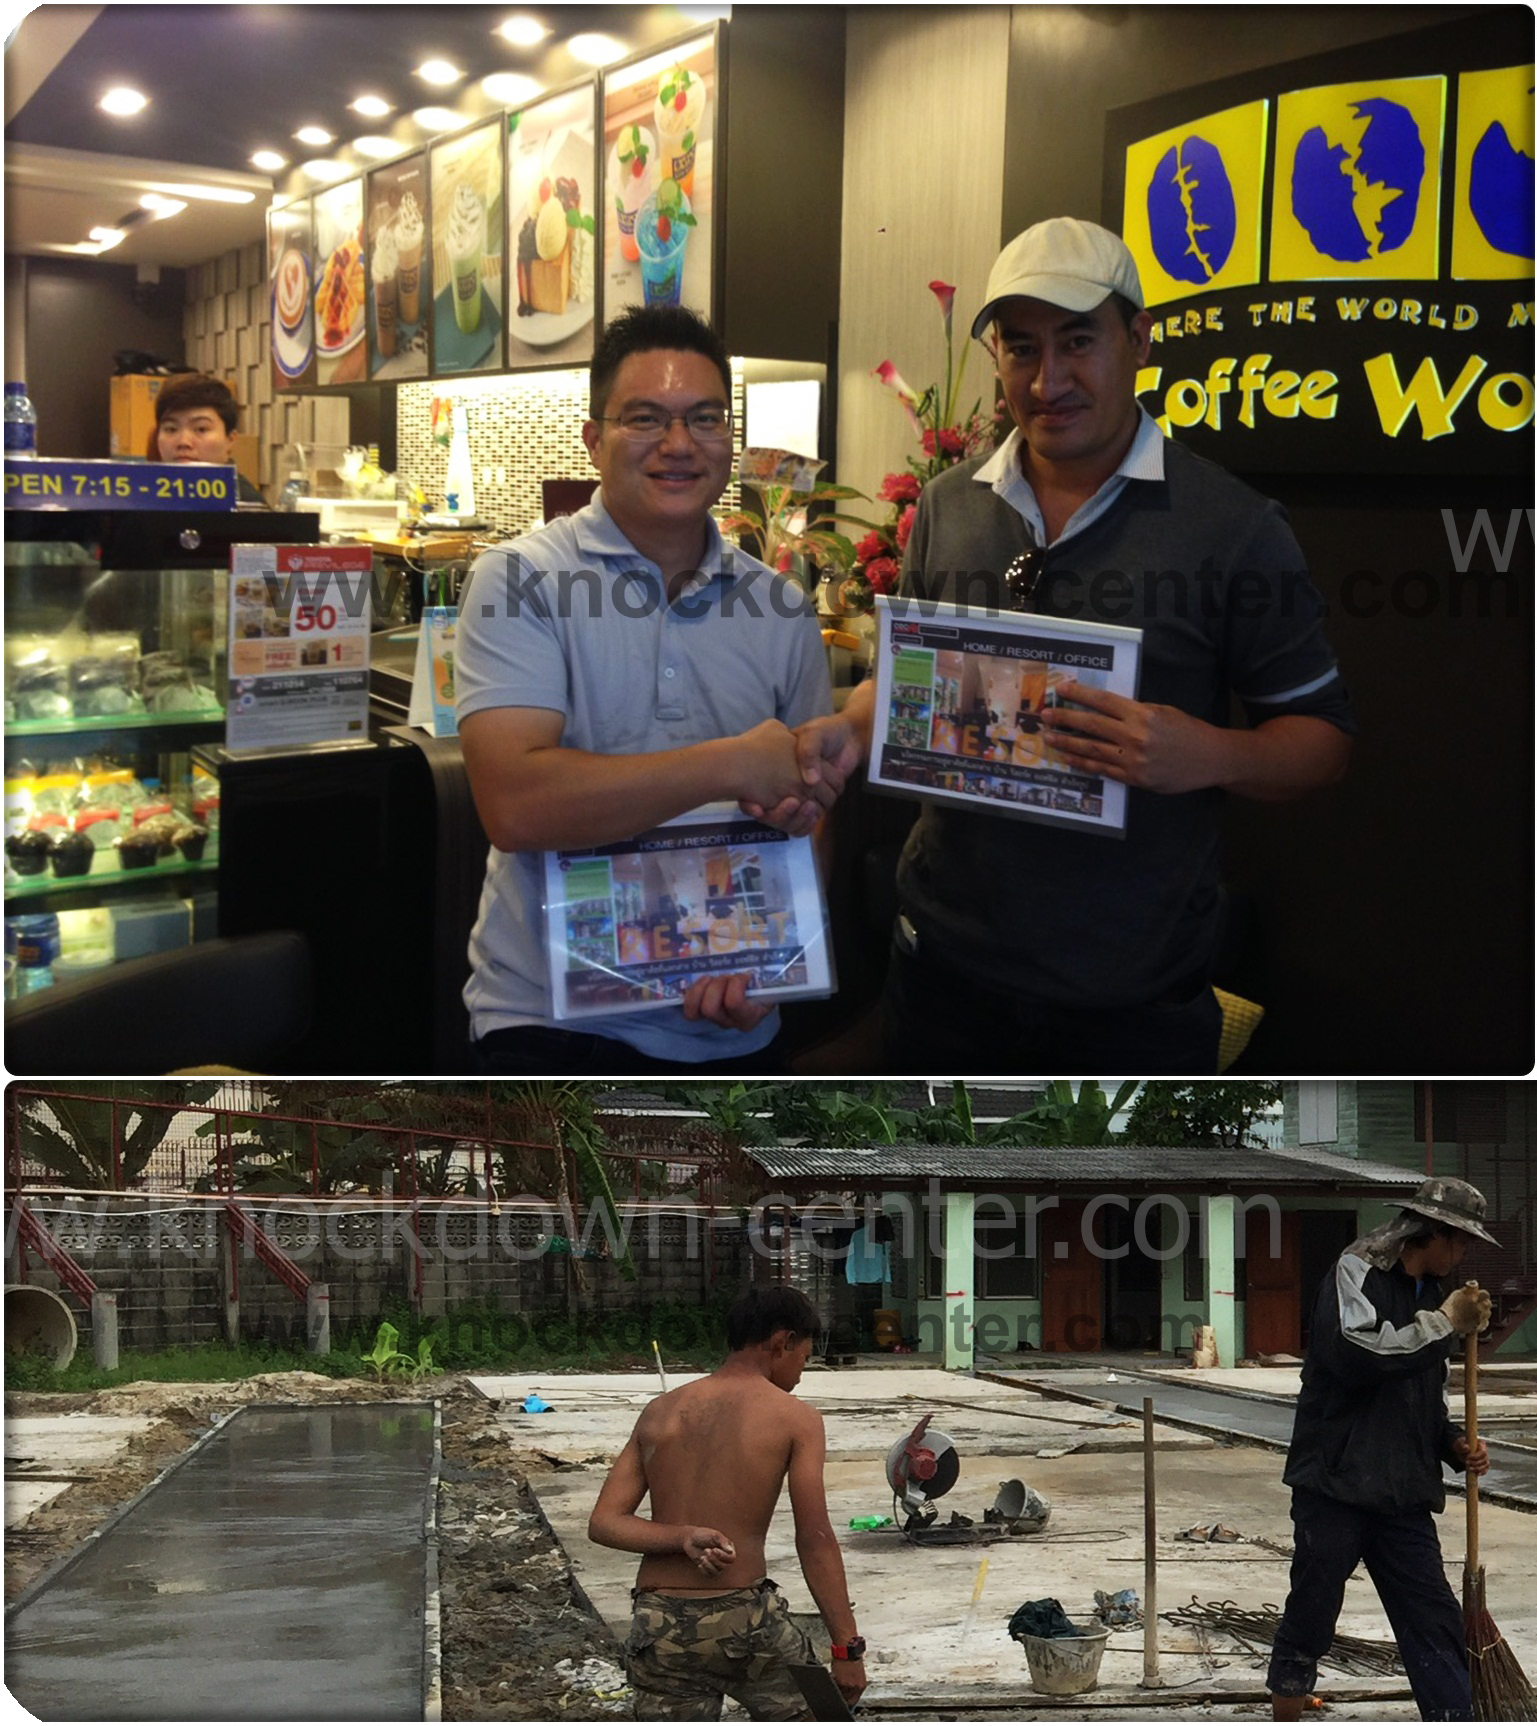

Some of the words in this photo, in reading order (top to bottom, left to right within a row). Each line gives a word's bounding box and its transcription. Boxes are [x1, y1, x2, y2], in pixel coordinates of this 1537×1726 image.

[1148, 306, 1224, 344] HERE
[1247, 296, 1316, 327] THE
[1335, 297, 1479, 332] WORLD
[1506, 301, 1536, 329] M
[1363, 352, 1536, 442] Wo
[4, 474, 62, 496] PEN
[71, 475, 131, 497] 7:15
[156, 478, 227, 500] 21:00
[295, 604, 337, 632] 50
[963, 641, 996, 655] HOME
[1006, 647, 1055, 661] RESORT
[1064, 653, 1109, 668] OFFICE
[639, 838, 675, 851] HOME
[684, 833, 735, 846] RESORT
[742, 829, 785, 843] OFFICE
